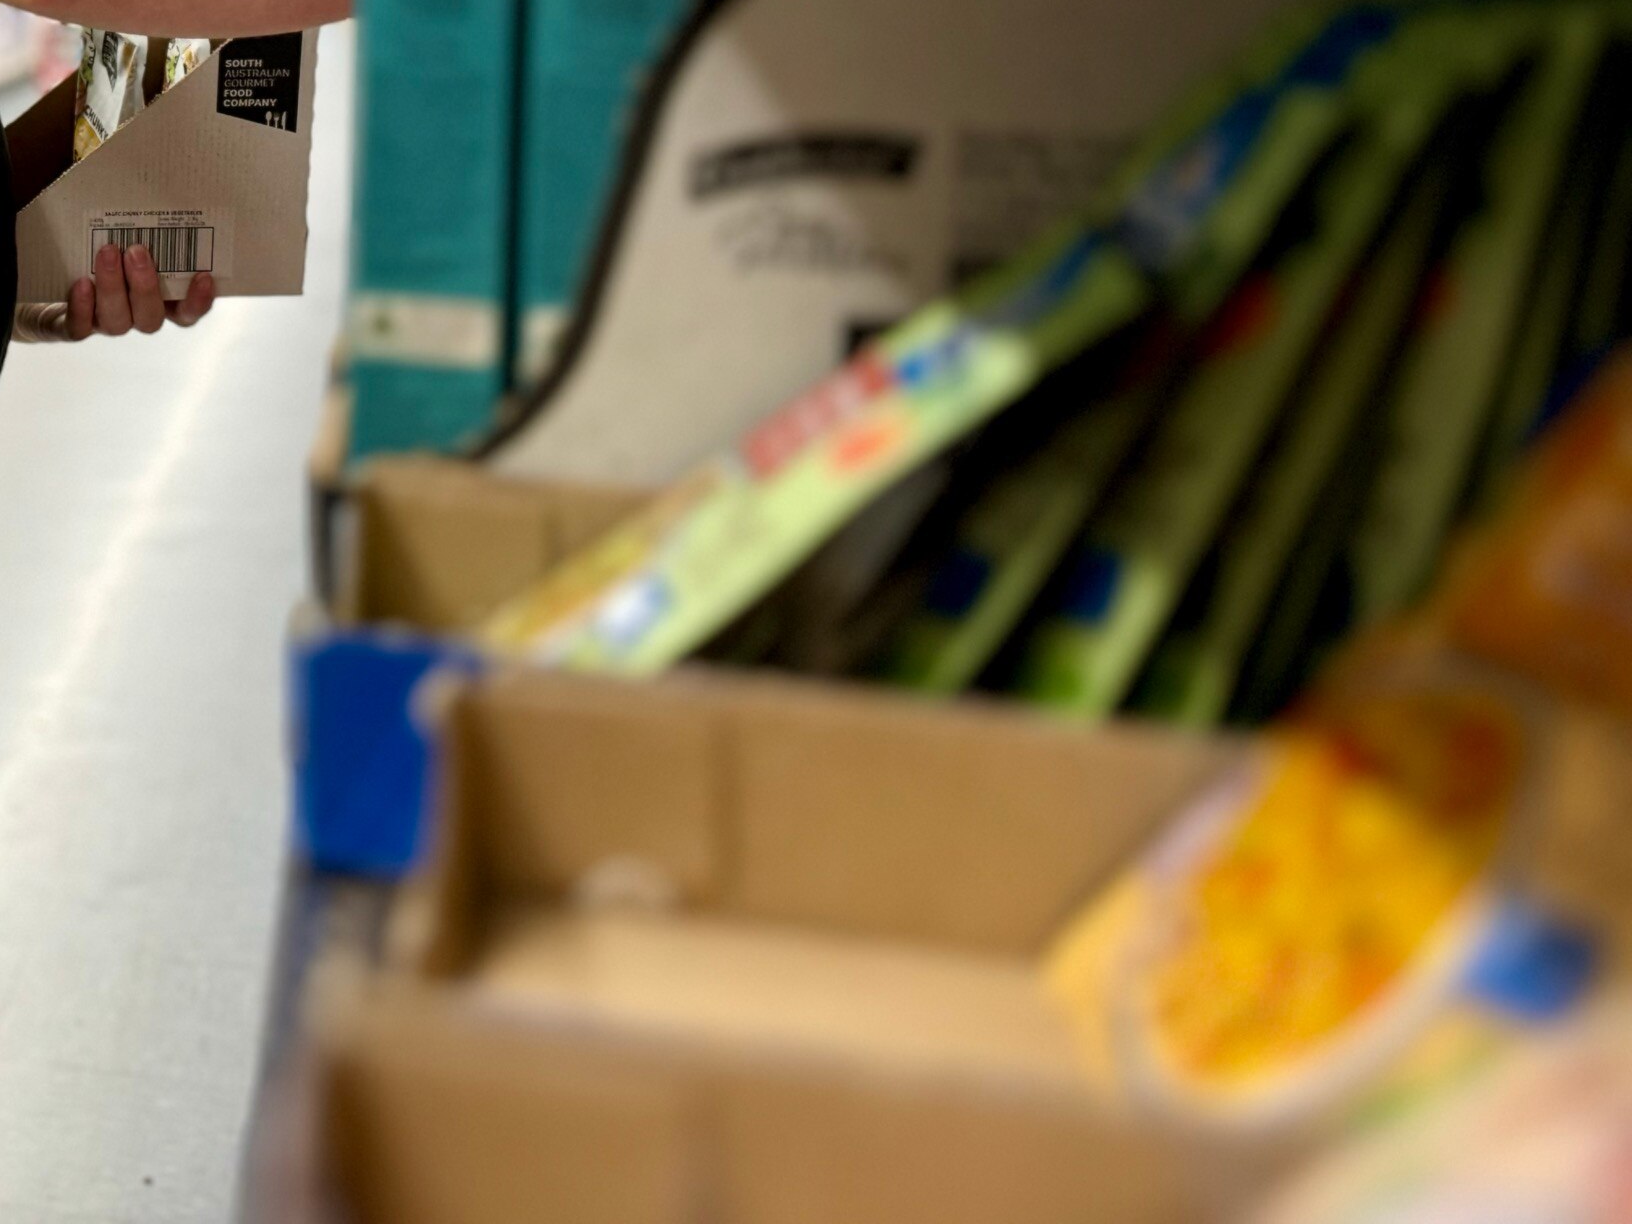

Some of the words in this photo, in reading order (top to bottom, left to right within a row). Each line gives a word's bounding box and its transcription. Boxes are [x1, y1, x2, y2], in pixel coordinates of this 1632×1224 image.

[225, 59, 263, 67] SOUTH
[225, 69, 290, 78] AUSTRALIAN
[224, 79, 275, 87] GOURMET
[224, 89, 253, 97] FOOD
[223, 98, 278, 107] COMPANY
[85, 104, 109, 141] CHUNKY
